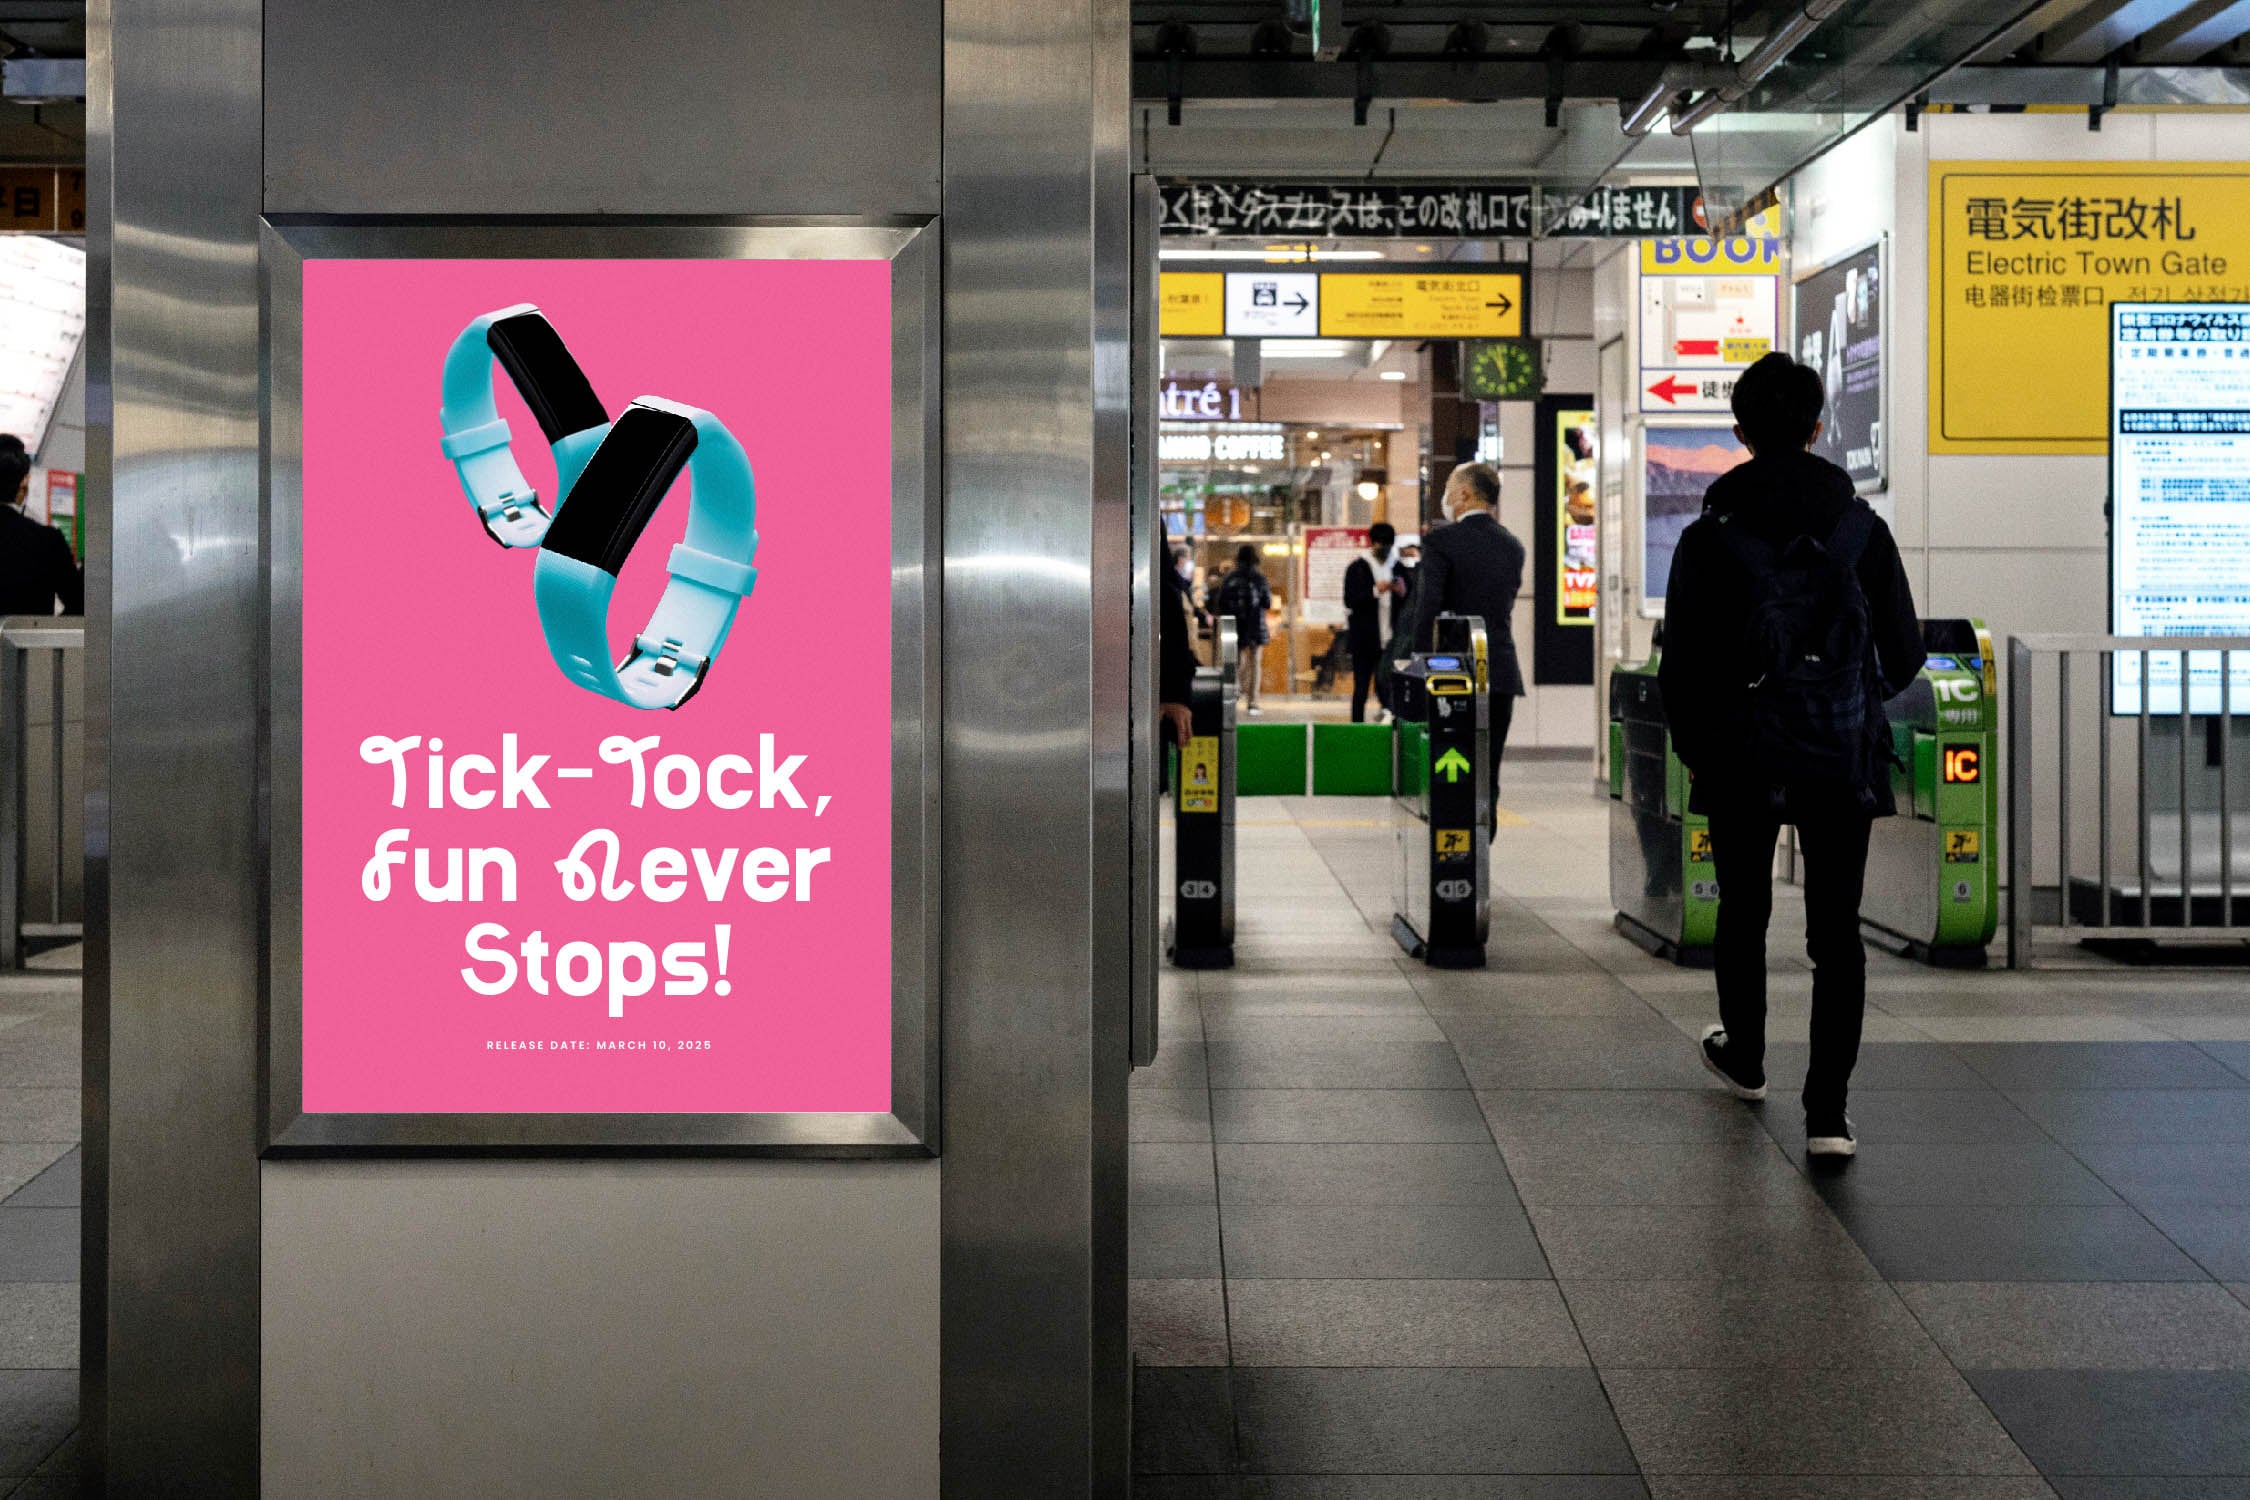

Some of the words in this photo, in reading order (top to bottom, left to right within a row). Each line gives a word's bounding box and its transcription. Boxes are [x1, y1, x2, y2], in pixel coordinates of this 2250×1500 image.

[1965, 196, 2196, 241] 電気街改札
[1966, 250, 2067, 276] Electric
[2075, 250, 2150, 276] Town
[2161, 250, 2228, 276] Gate
[1965, 285, 2105, 309] 电器街检票口
[1934, 679, 1979, 702] IC
[359, 733, 833, 817] Tick-Tock,
[1945, 749, 1978, 782] IC
[361, 827, 518, 903] Fun
[553, 827, 831, 903] Never
[460, 922, 732, 1018] Stops!
[486, 1040, 544, 1051] RELEASE
[550, 1040, 590, 1051] DATE:
[596, 1040, 647, 1051] MARCH
[652, 1040, 671, 1052] 10,
[677, 1040, 712, 1051] 2025
